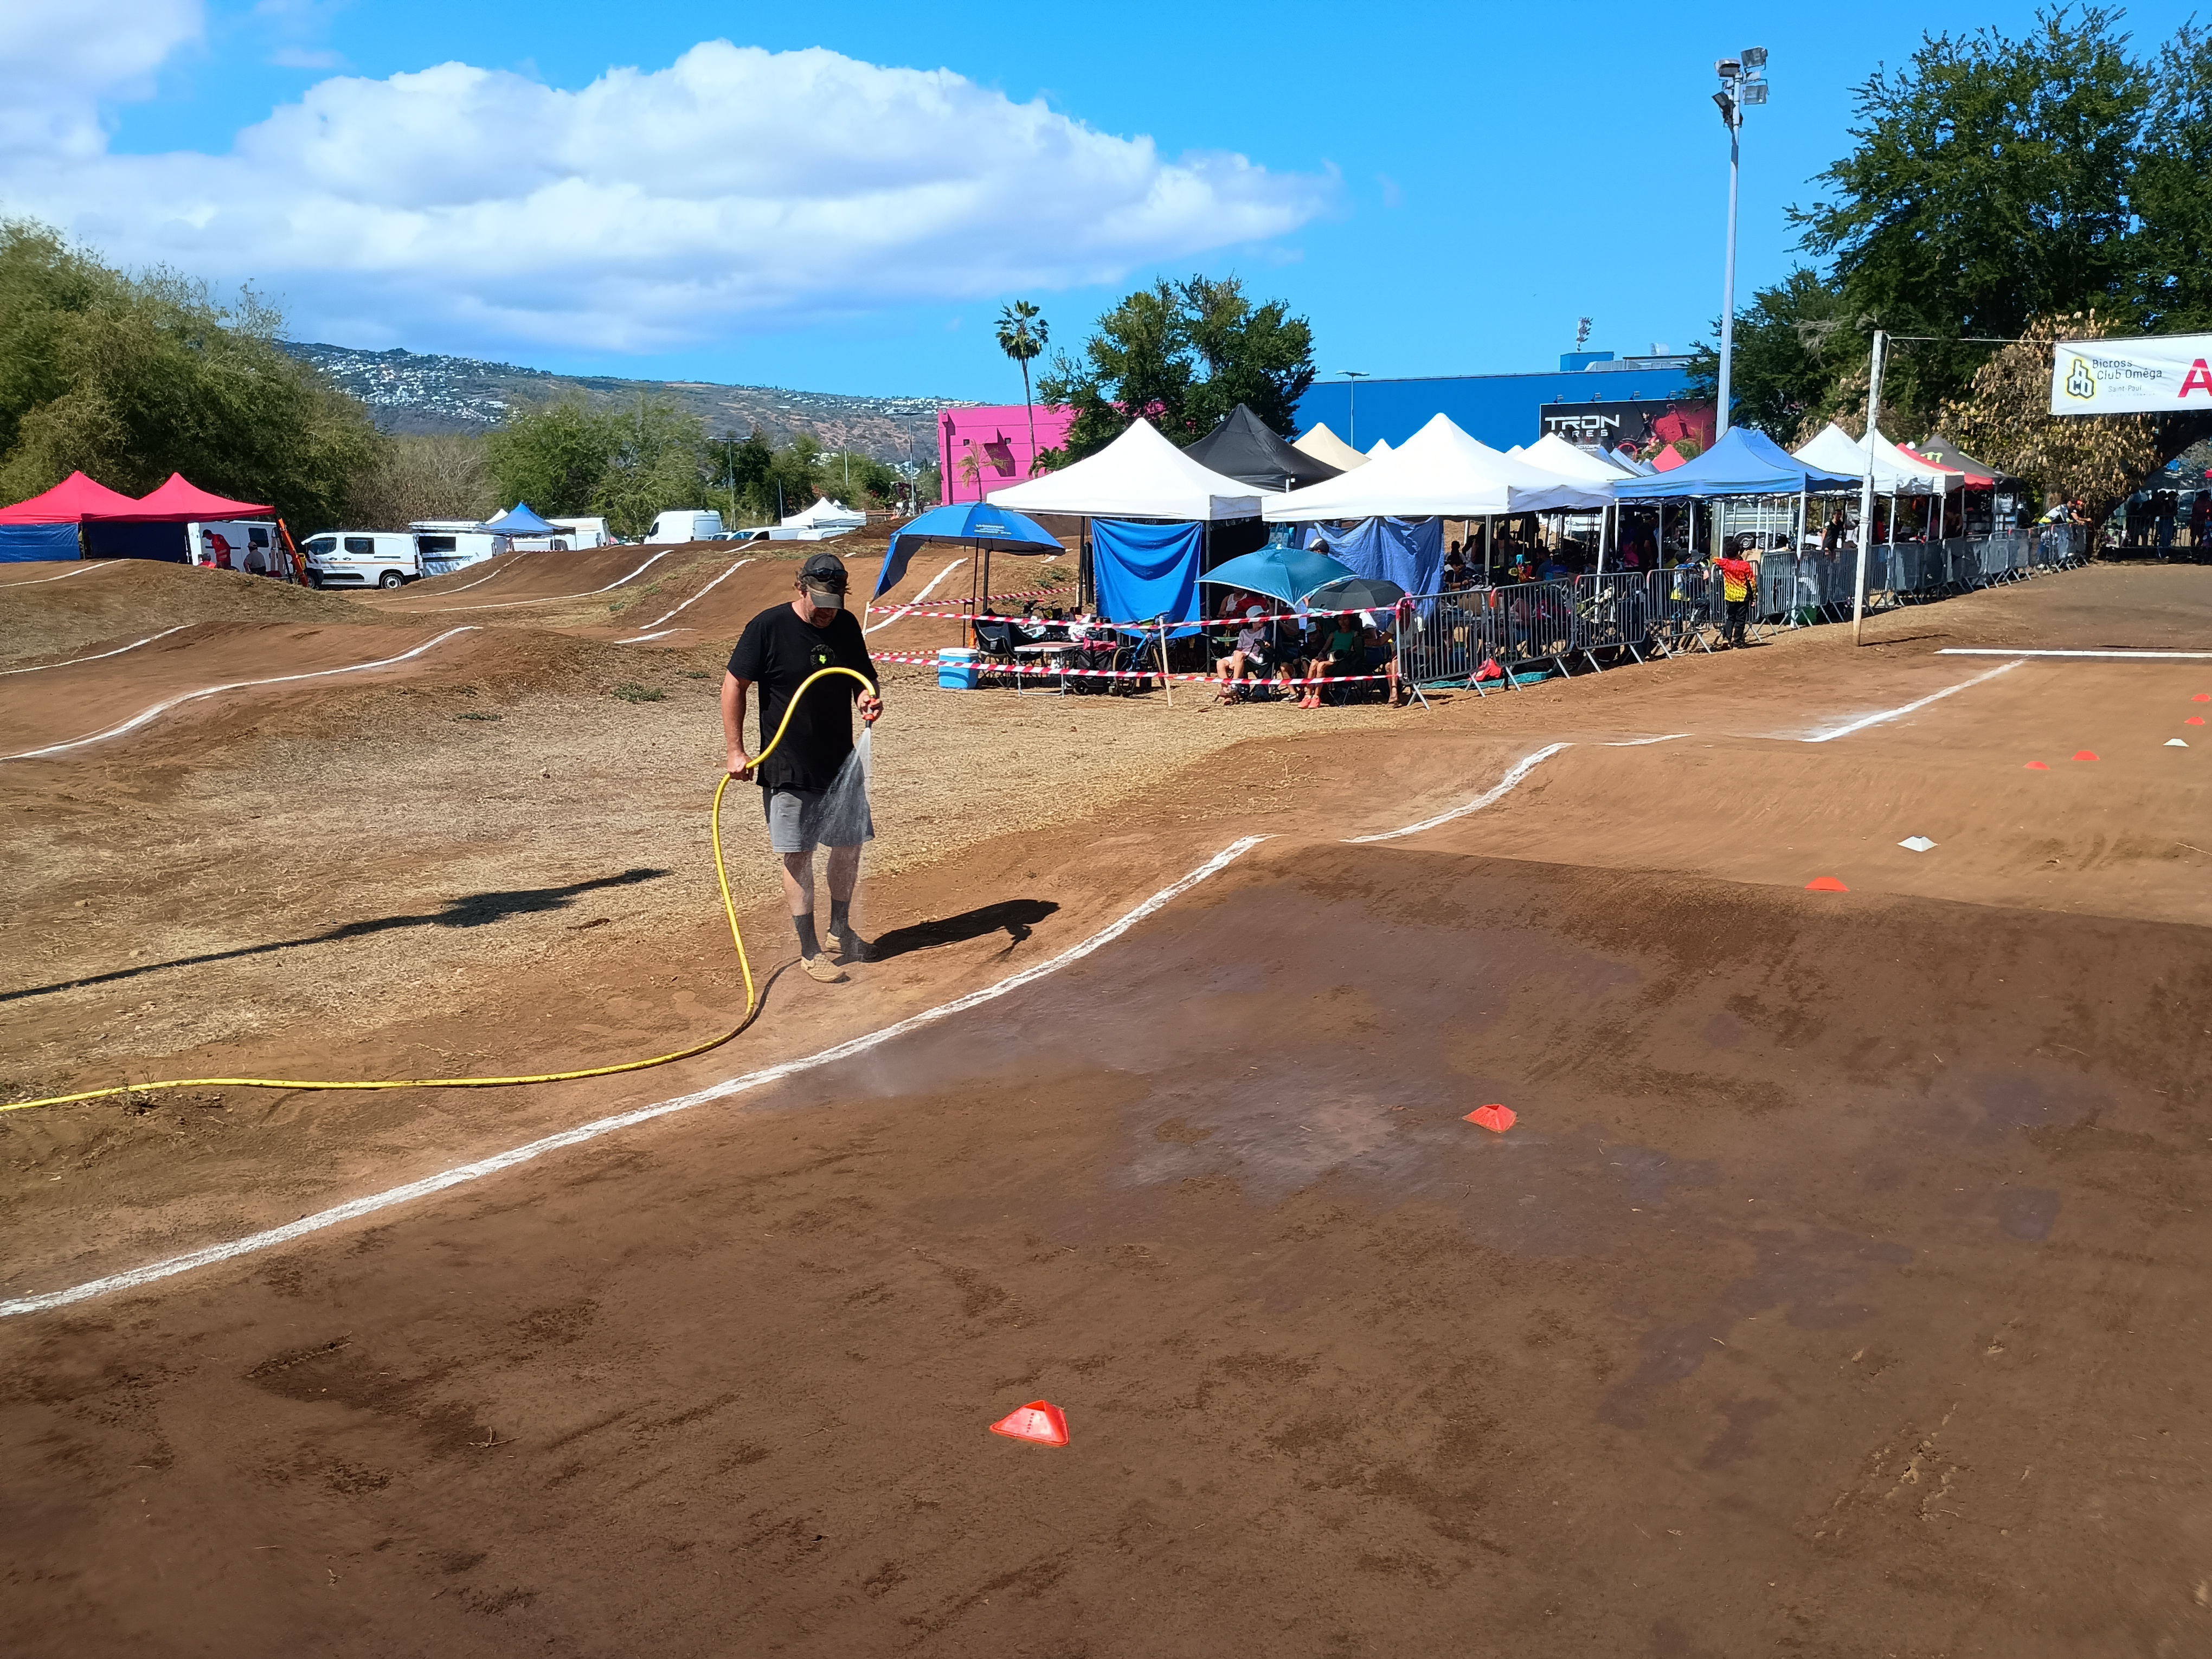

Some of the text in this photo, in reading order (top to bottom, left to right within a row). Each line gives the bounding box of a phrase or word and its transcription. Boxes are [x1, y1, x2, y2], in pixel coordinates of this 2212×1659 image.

[2092, 359, 2133, 368] Bicross
[2097, 368, 2162, 380] Club Oméga
[1545, 414, 1620, 430] TRON
[1557, 429, 1609, 439] ARES
